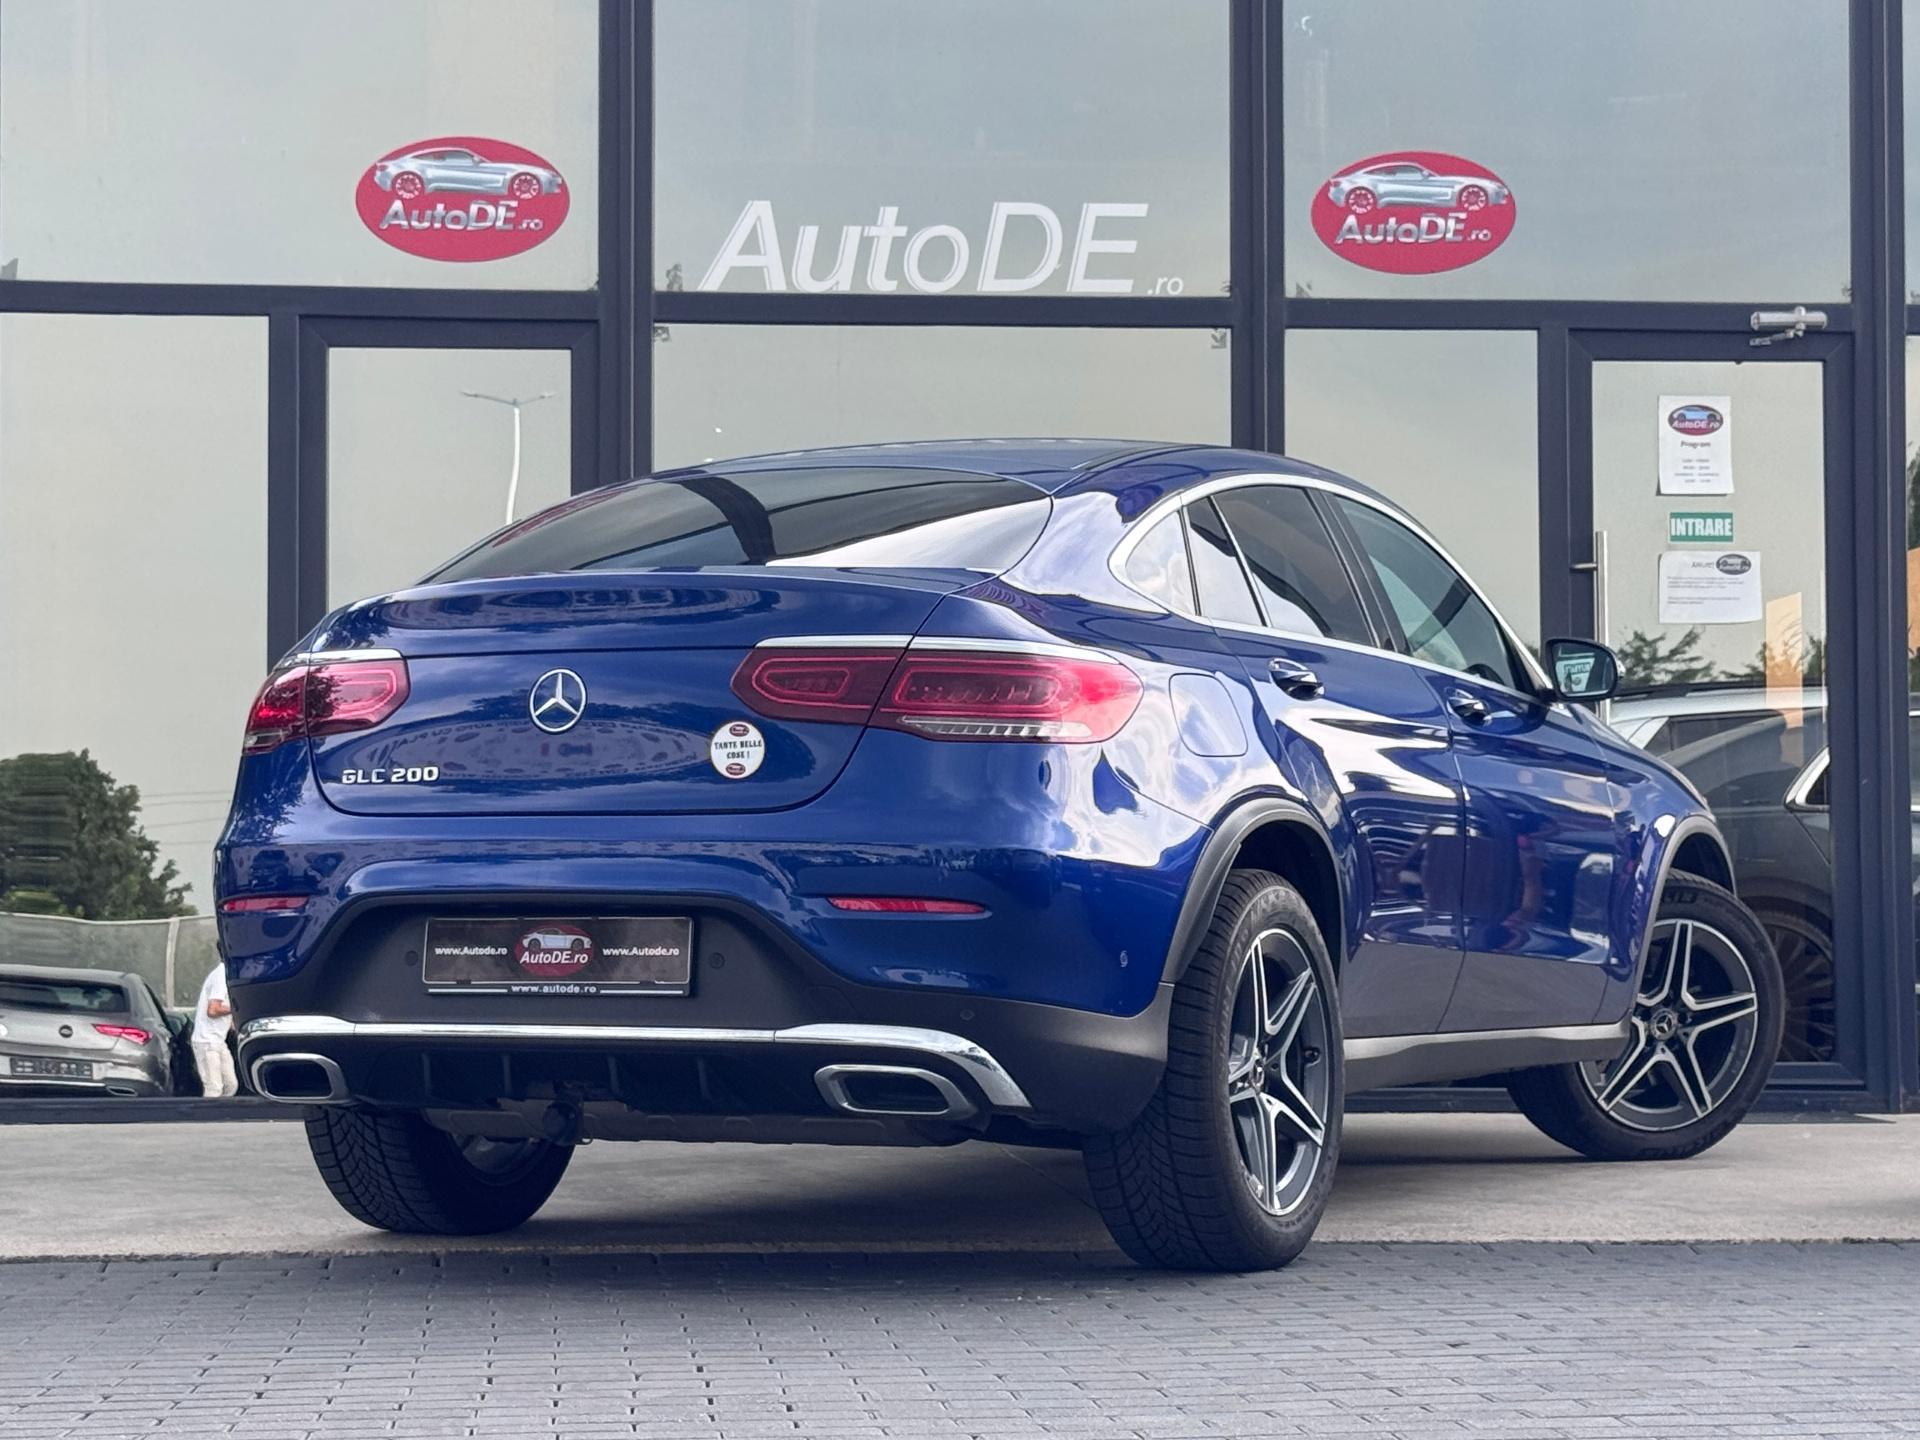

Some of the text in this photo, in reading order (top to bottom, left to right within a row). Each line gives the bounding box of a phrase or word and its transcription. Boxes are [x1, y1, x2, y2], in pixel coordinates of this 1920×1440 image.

[379, 199, 518, 231] AutoDE
[1334, 212, 1467, 244] AutoDE
[697, 200, 1185, 296] AutoDE .ro
[1670, 518, 1732, 536] INTRARE
[714, 739, 762, 749] TANTE BELLE
[341, 766, 439, 784] GLC 200
[435, 946, 508, 955] www.Autode.ro
[520, 951, 589, 964] AutoDE.ro
[602, 946, 680, 956] www.Autode.ro
[511, 984, 596, 995] www.autode.ro
